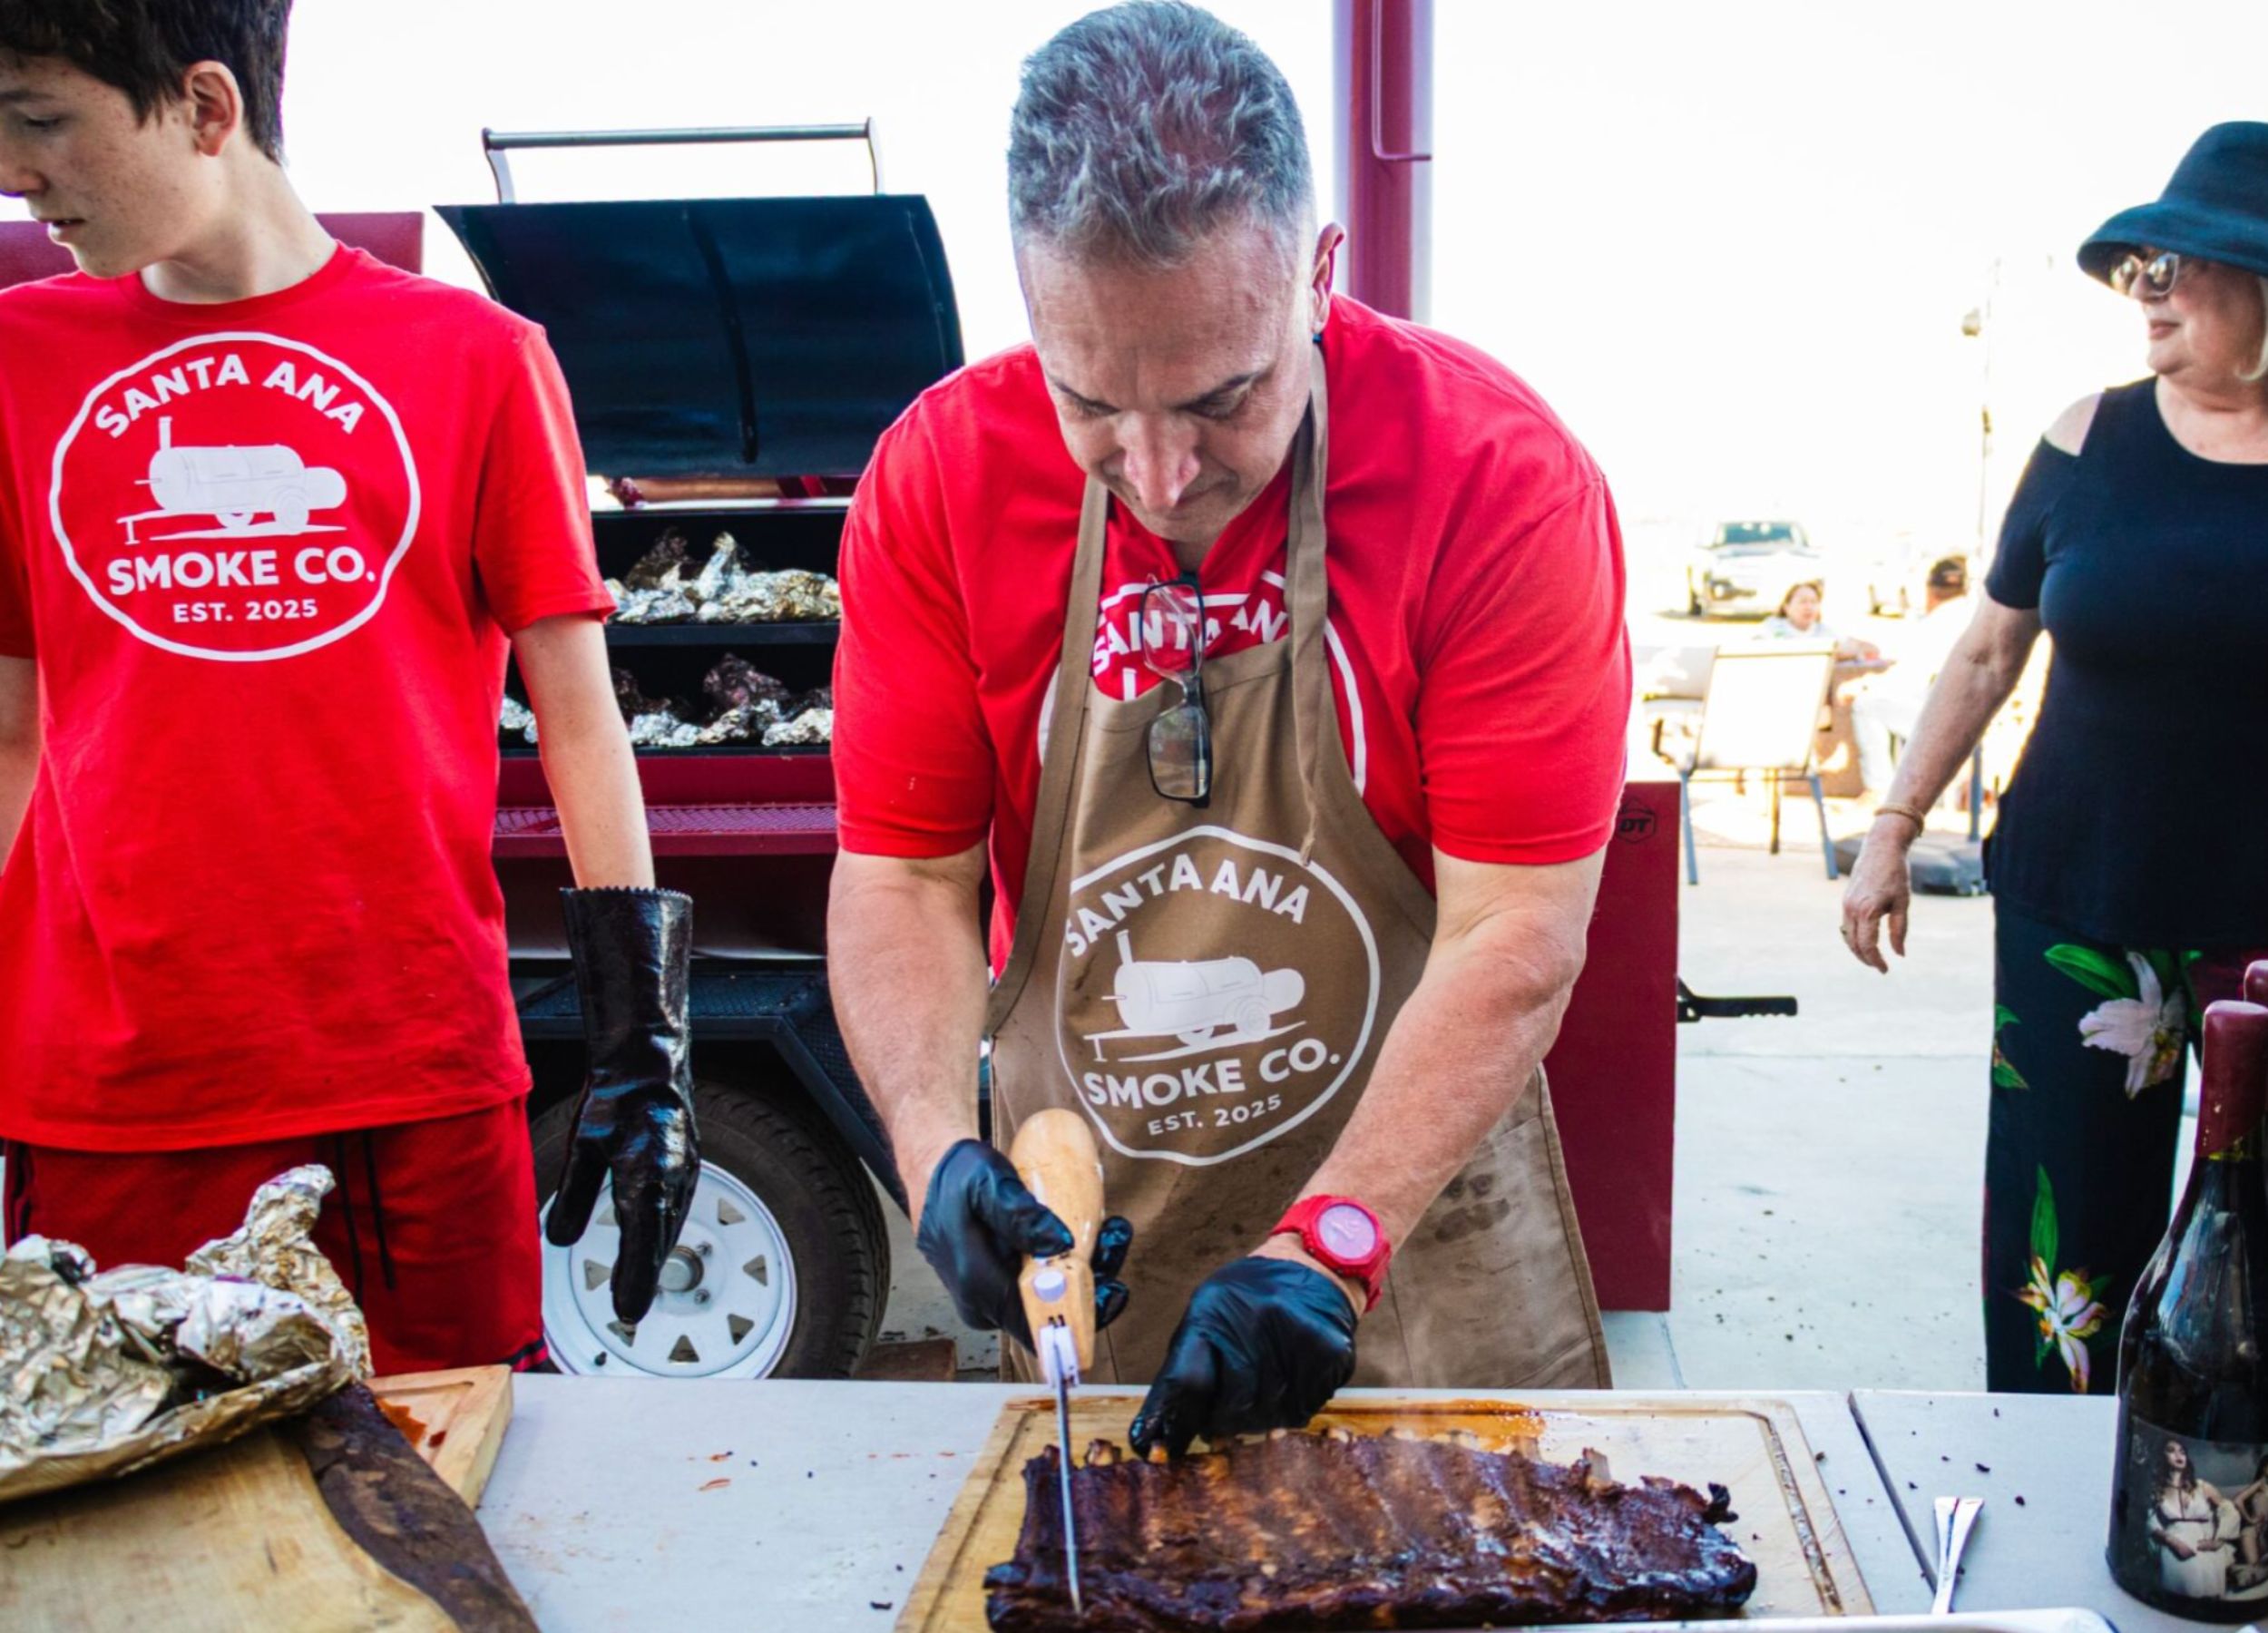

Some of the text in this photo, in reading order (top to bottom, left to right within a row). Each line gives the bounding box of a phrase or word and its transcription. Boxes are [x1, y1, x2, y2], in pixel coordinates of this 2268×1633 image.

[95, 354, 365, 438] SANTA ANA
[107, 546, 375, 595] SMOKE CO.
[172, 599, 318, 622] EST. 2025
[1092, 599, 1287, 677] SANTA AN
[1065, 853, 1309, 958] SANTA ANA
[1083, 1038, 1340, 1109] SMOKE CO.
[1148, 1094, 1282, 1136] EST. 2025
